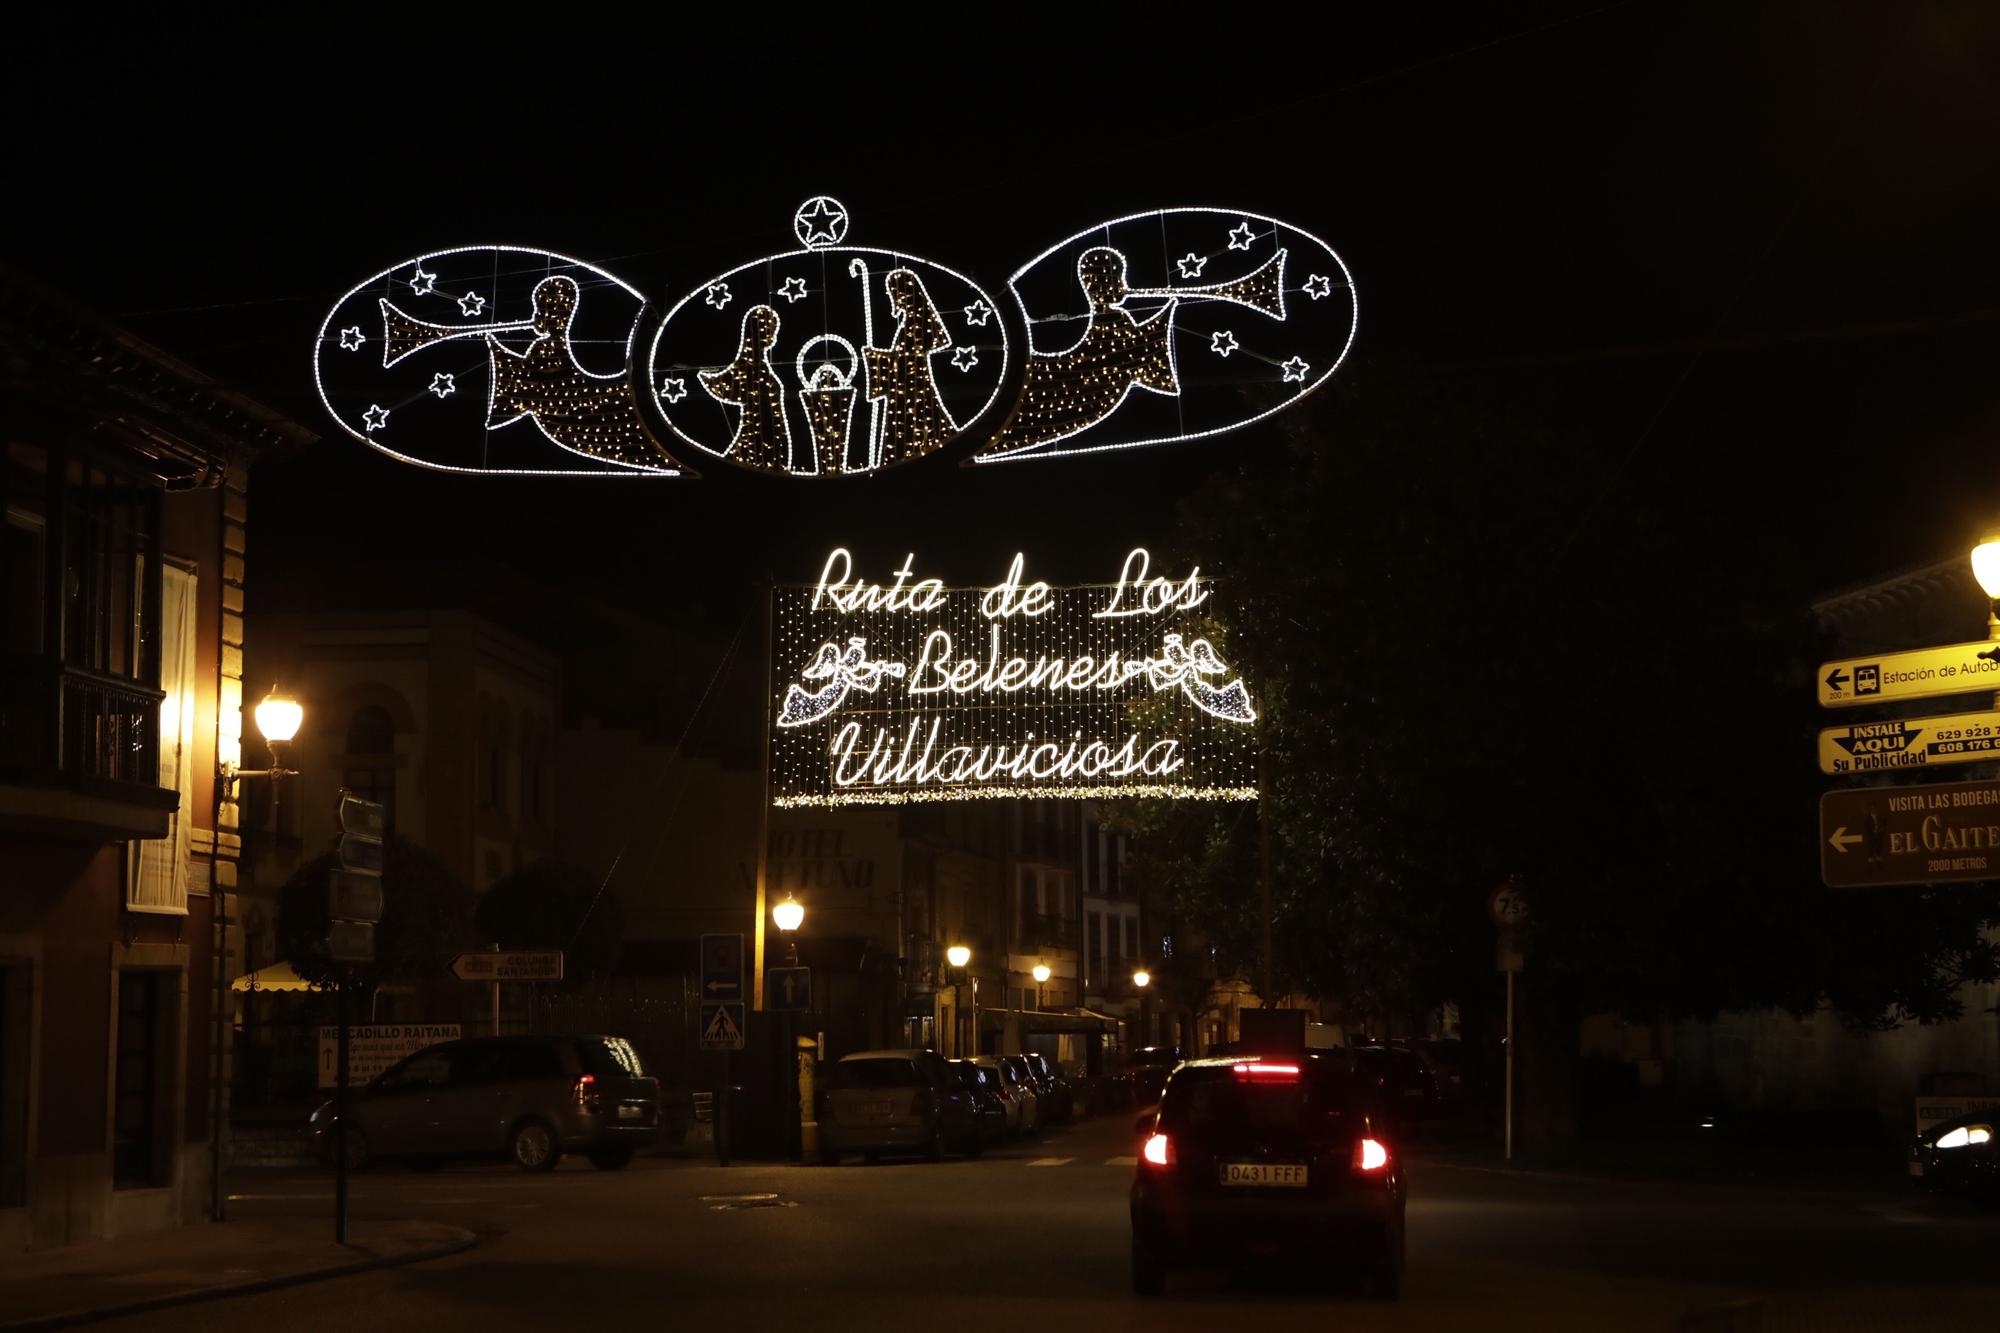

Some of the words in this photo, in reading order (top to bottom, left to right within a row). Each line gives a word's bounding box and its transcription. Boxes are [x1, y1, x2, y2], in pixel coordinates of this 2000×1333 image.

[981, 552, 1054, 620] de
[1092, 547, 1210, 618] Los
[908, 623, 1120, 695] Belenes
[1883, 667, 1935, 684] Estación
[1939, 665, 1956, 678] de
[1830, 691, 1842, 700] 200
[1854, 722, 1902, 739] INSTALE
[1937, 730, 1961, 740] 629
[1965, 726, 1991, 738] 928
[830, 715, 1184, 787] Villaviciosa
[1852, 735, 1905, 753] AQUI
[1938, 742, 1964, 753] 608
[1967, 739, 1991, 750] 176
[1833, 758, 1849, 772] Su
[1854, 748, 1926, 770] Publicidad
[1888, 795, 1925, 812] VISITA
[1928, 793, 1950, 809] LAS
[1953, 789, 2000, 807] BODEGA
[1889, 831, 1919, 855] EL
[1928, 858, 1951, 872] 2000
[1952, 857, 1987, 871] METROS
[321, 1026, 400, 1040] MECADILLO
[404, 1026, 460, 1039] RAITANA
[1230, 1166, 1268, 1181] 0431
[1274, 1167, 1304, 1182] FFF
